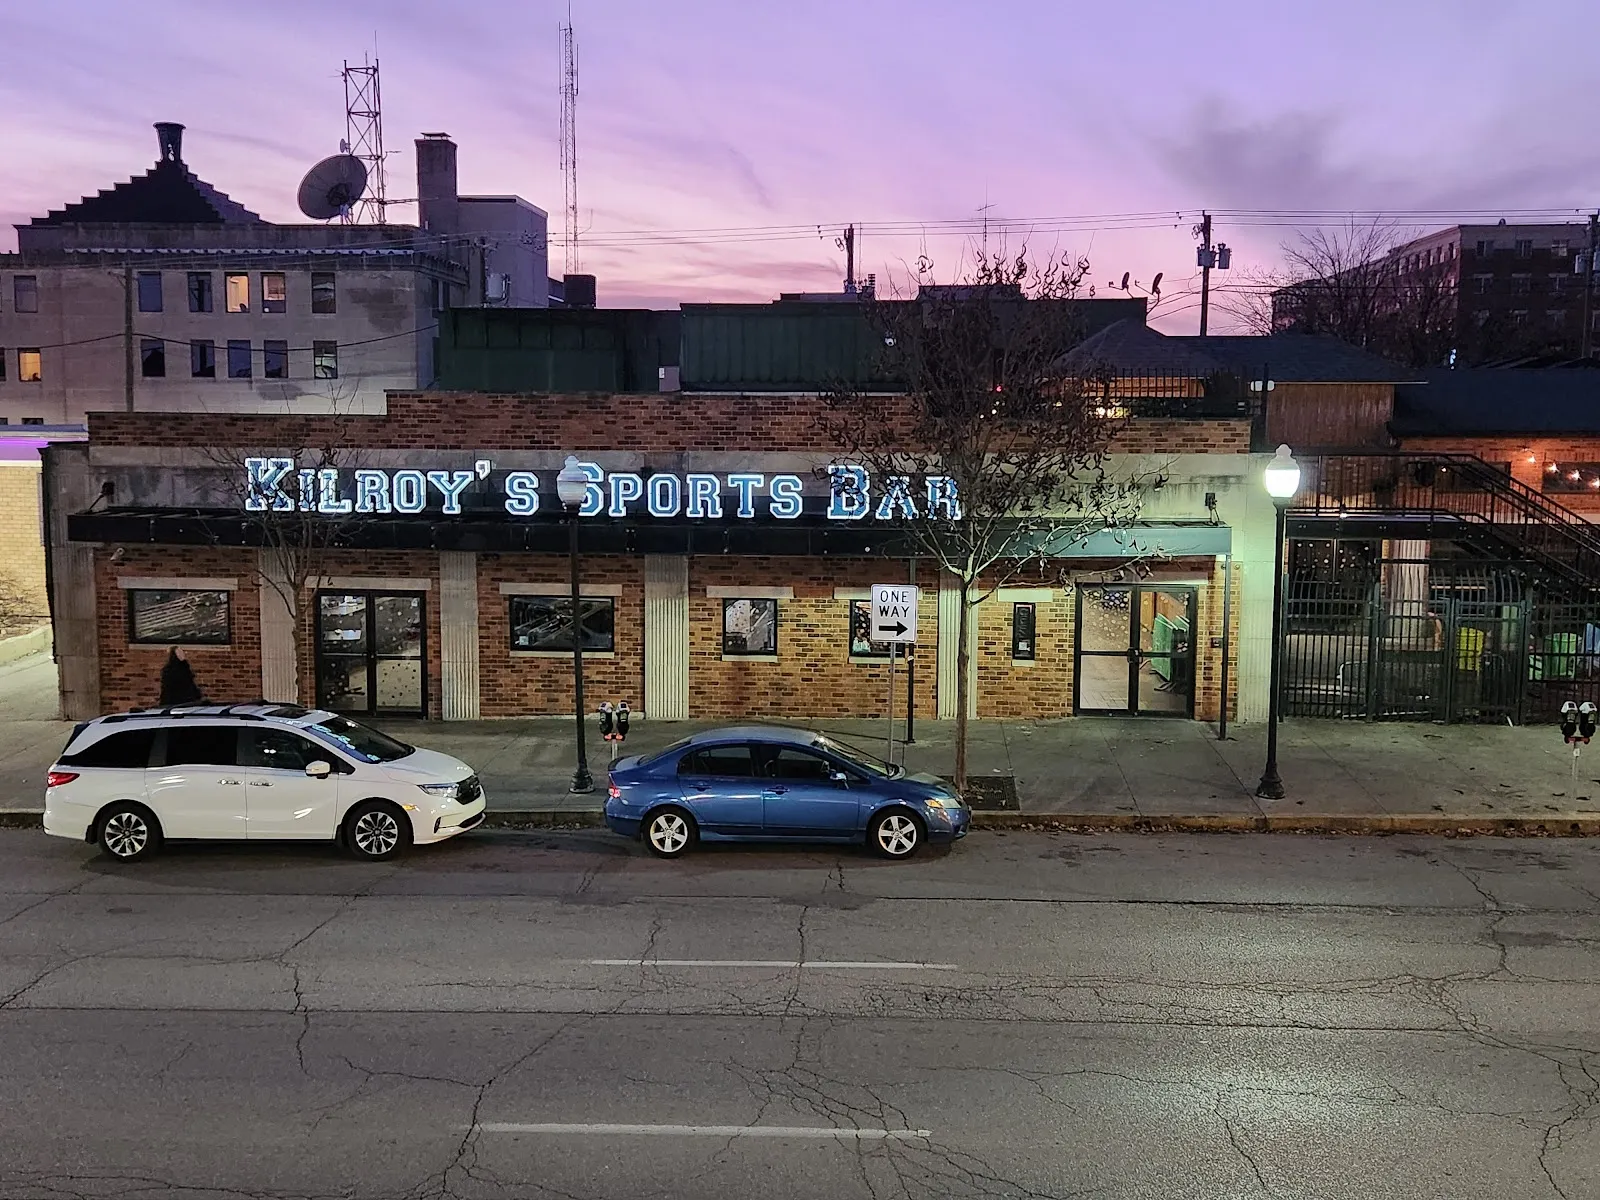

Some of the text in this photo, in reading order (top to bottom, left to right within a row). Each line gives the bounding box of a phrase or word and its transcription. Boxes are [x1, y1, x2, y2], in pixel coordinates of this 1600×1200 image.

[245, 457, 540, 516] KILROY'S
[827, 465, 962, 520] BAR
[880, 590, 909, 602] ONE
[879, 605, 910, 618] WAY
